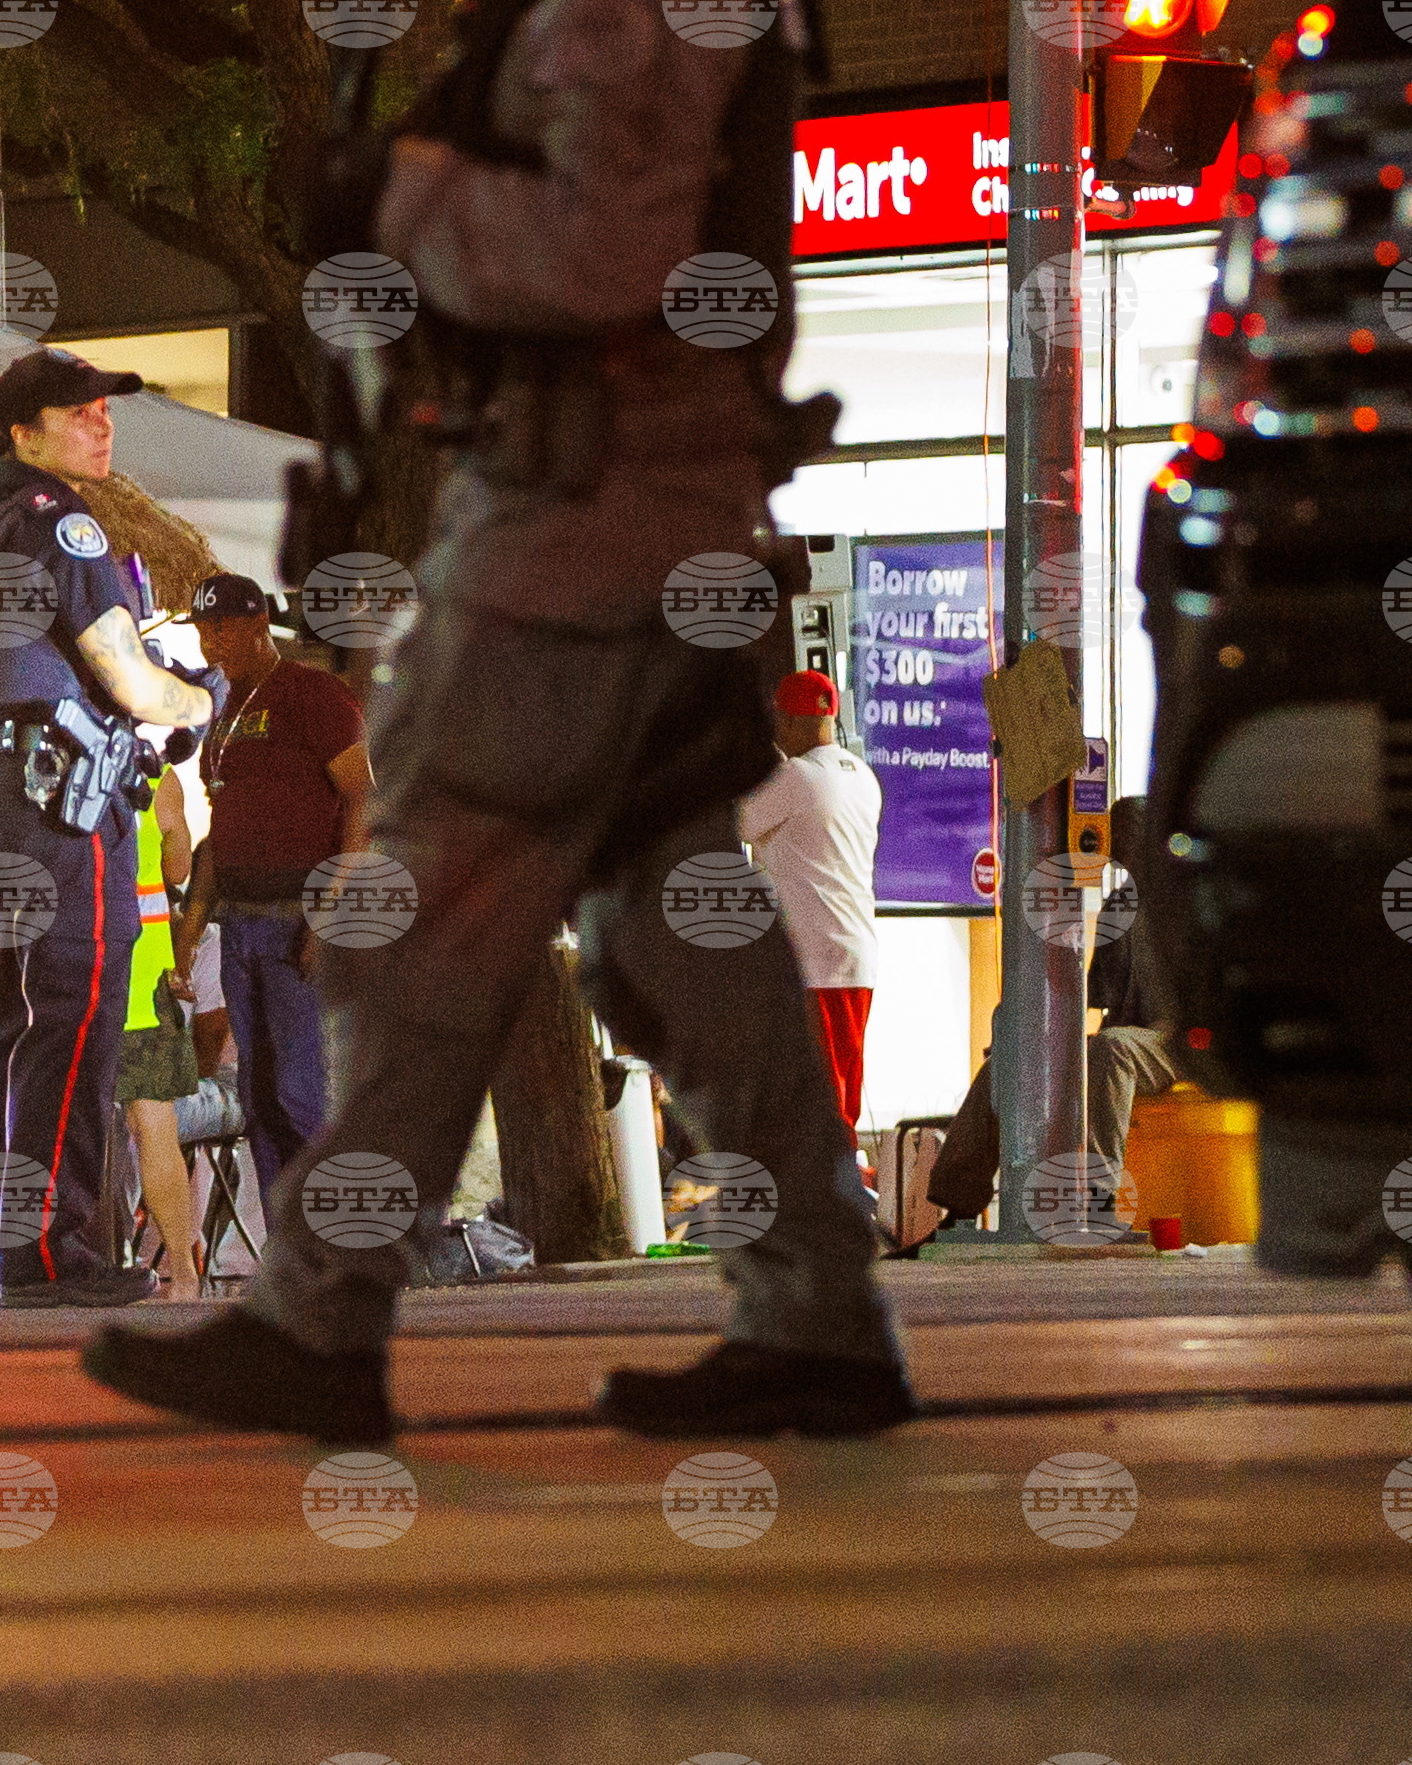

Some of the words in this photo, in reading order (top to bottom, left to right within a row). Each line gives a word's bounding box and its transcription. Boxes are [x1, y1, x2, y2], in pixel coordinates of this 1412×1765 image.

[794, 146, 912, 224] Mart
[868, 561, 967, 597] Borrow
[868, 611, 929, 642] your
[933, 602, 989, 640] first
[864, 648, 934, 686] $300
[864, 701, 898, 726] on
[902, 746, 948, 770] Payday
[950, 747, 991, 768] Boost.
